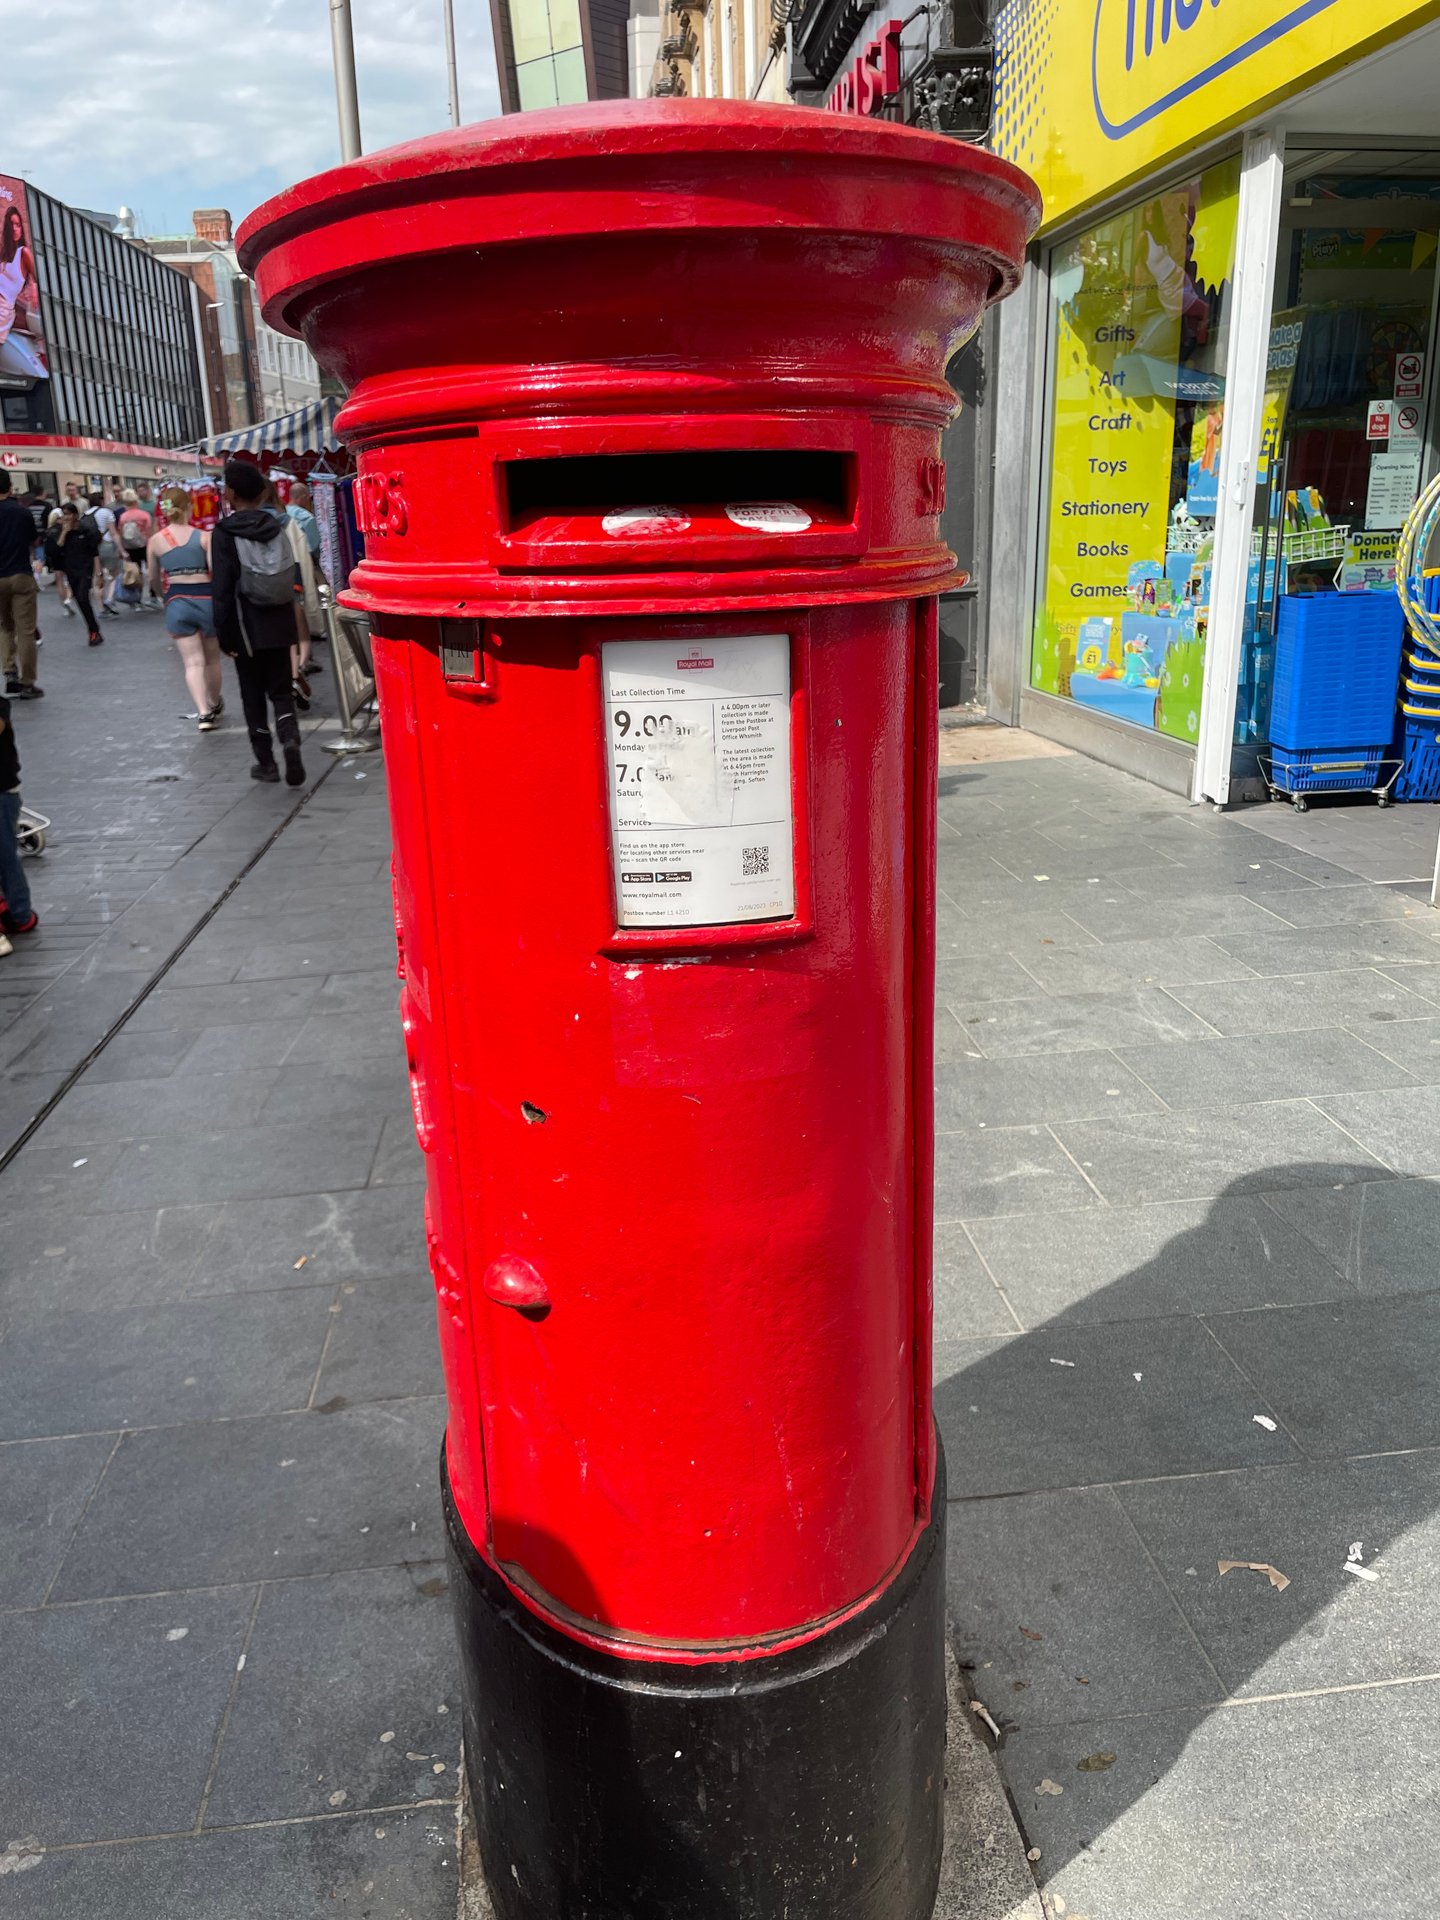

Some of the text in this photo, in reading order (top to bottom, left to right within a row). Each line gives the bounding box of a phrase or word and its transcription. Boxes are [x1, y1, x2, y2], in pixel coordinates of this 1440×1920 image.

[1095, 324, 1135, 343] Gifts
[1100, 370, 1126, 387] Art
[1088, 412, 1132, 431] Craft
[1088, 458, 1127, 477] Toys
[1376, 464, 1399, 472] Opening
[1061, 500, 1150, 518] Stationery
[1077, 540, 1128, 557] Books
[1360, 546, 1396, 560] Here!
[1070, 583, 1128, 598] Games
[679, 660, 697, 669] Royal
[611, 687, 686, 697] Last Collection Time
[721, 711, 747, 719] collection
[721, 726, 747, 734] Liverpool
[614, 744, 646, 752] Monday
[618, 818, 652, 827] Services
[622, 891, 682, 899] www.royalmail.com
